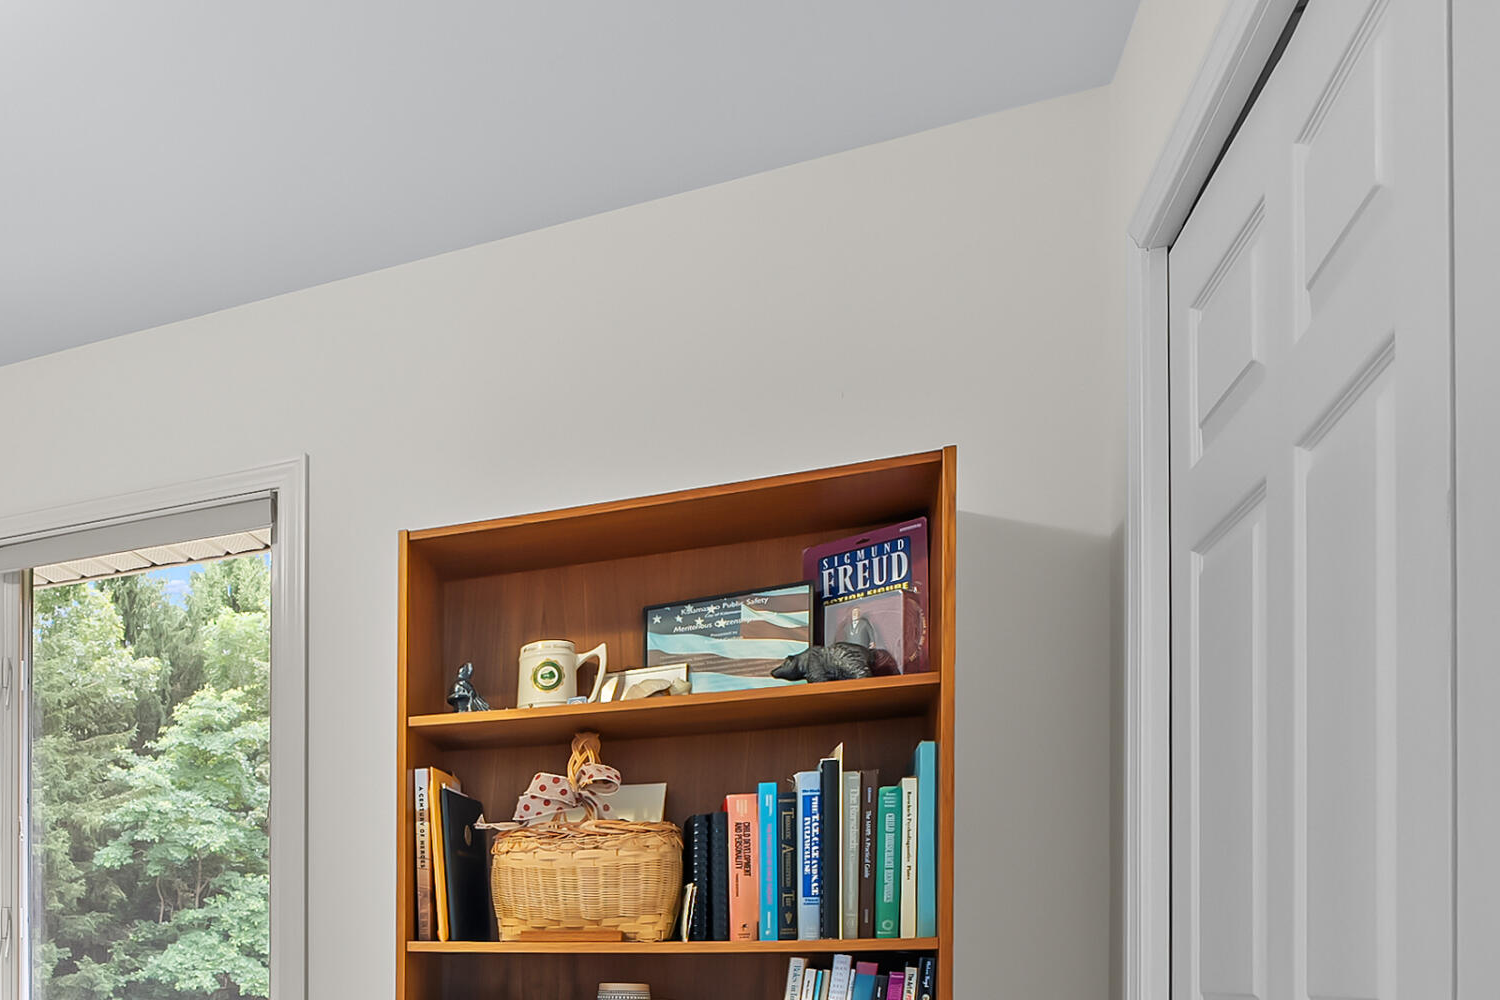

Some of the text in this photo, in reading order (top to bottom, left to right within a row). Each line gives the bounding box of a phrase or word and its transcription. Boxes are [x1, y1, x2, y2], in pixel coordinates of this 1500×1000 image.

[822, 538, 905, 570] SIGMUND
[821, 551, 909, 599] FREUD
[680, 604, 721, 616] Kalamazo
[746, 597, 769, 606] Safety
[419, 828, 425, 837] OF
[742, 821, 750, 838] CHILD
